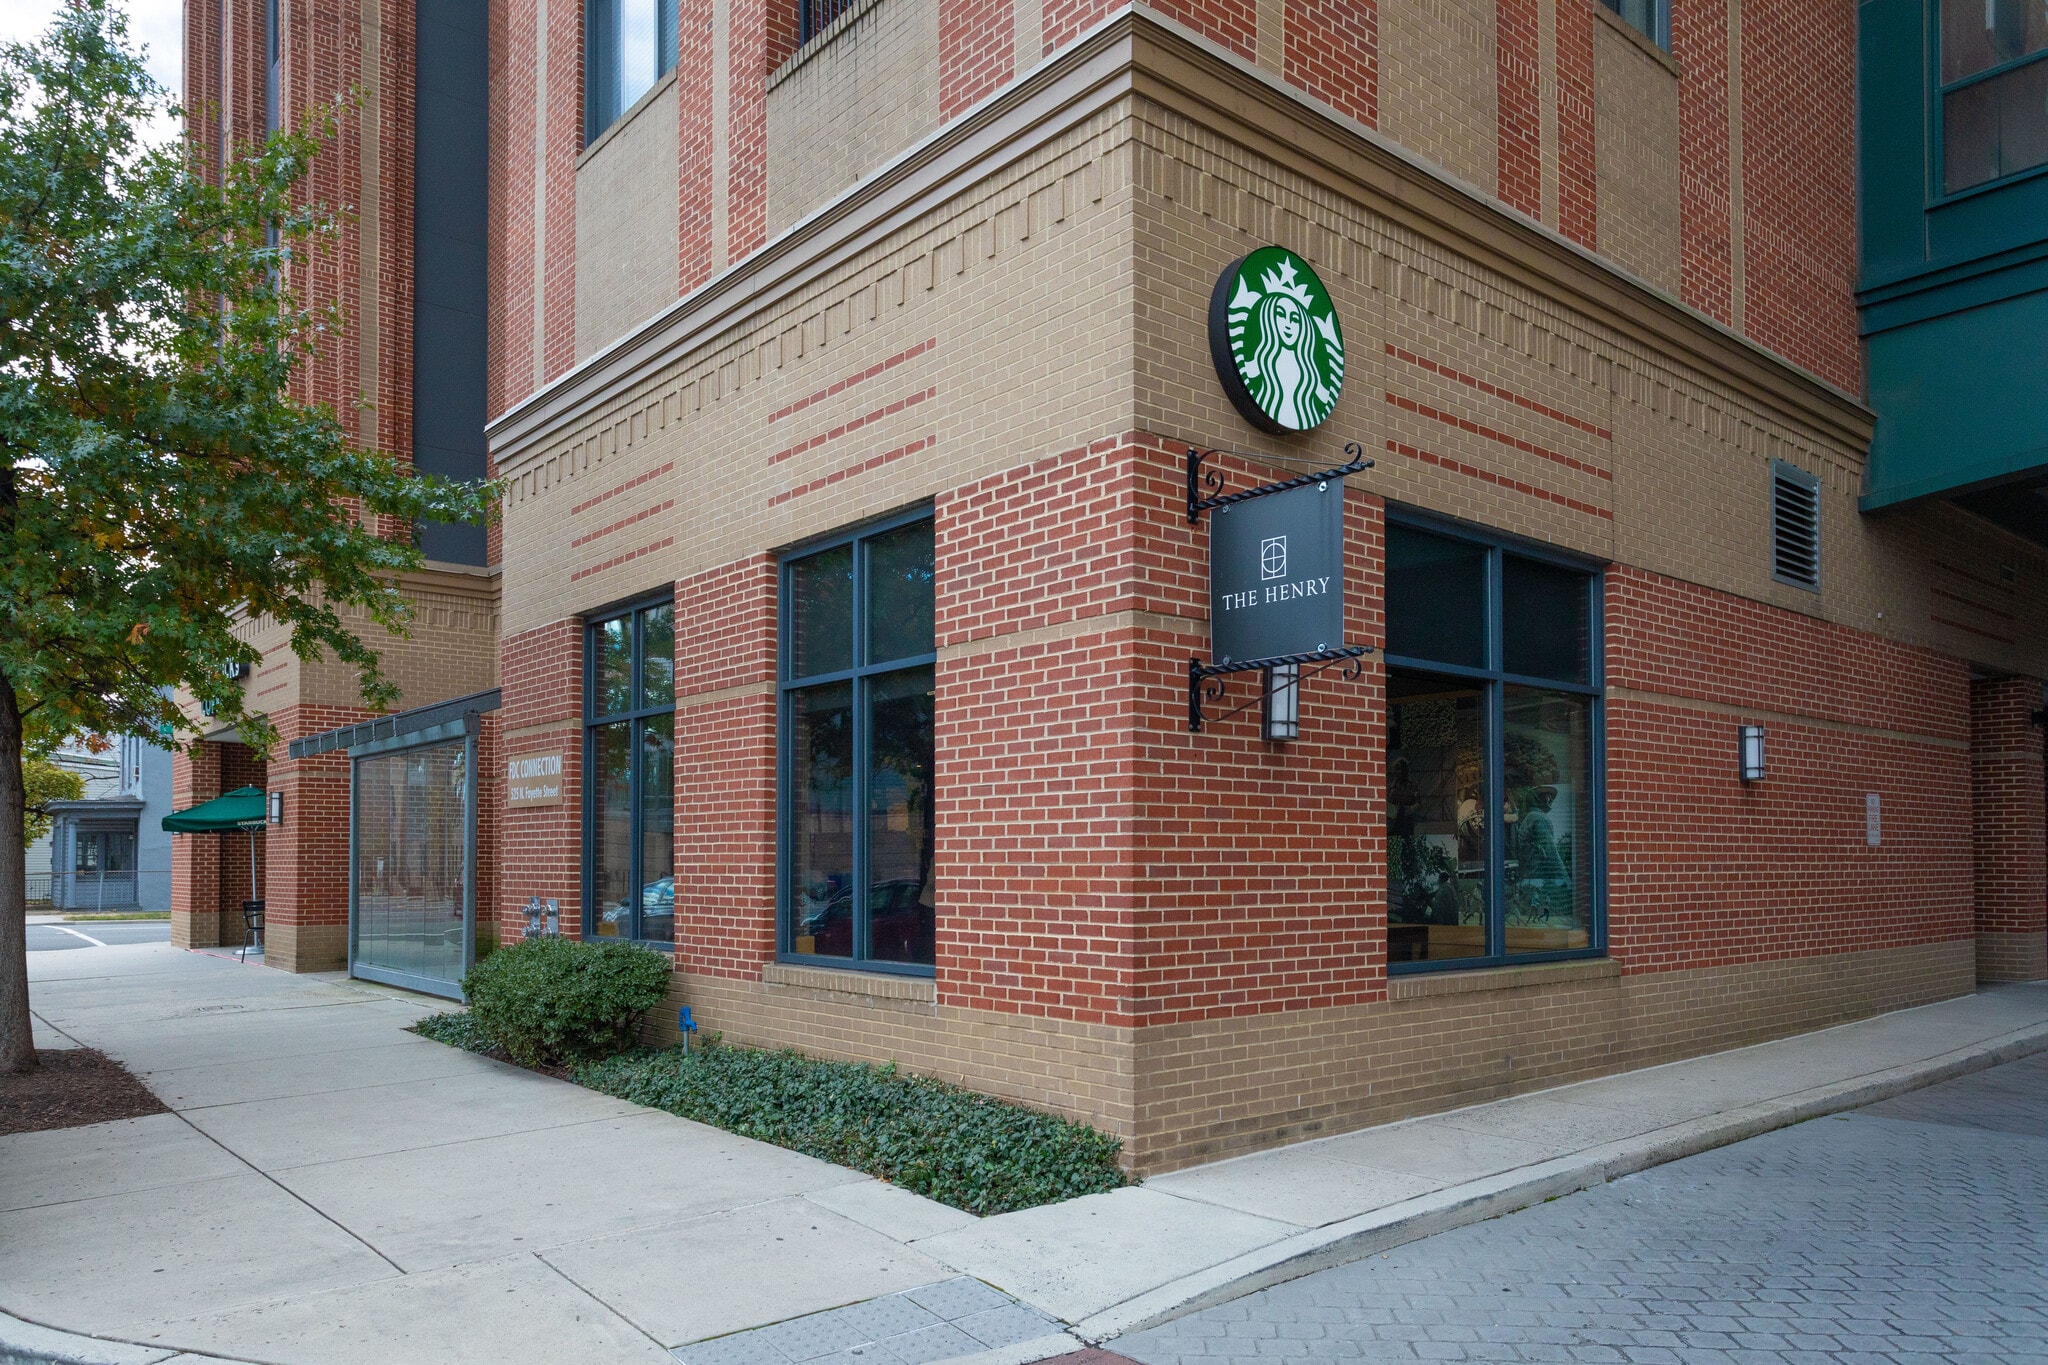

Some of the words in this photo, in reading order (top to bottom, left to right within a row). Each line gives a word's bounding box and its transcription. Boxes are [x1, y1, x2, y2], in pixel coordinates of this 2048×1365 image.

[1222, 590, 1258, 611] THE
[1265, 576, 1331, 604] HENRY
[508, 761, 519, 780] FDC
[520, 755, 562, 778] CONNECTION
[525, 786, 543, 802] Fayette
[543, 784, 559, 798] Street
[1868, 814, 1879, 823] FIRE
[1868, 823, 1880, 832] LANE
